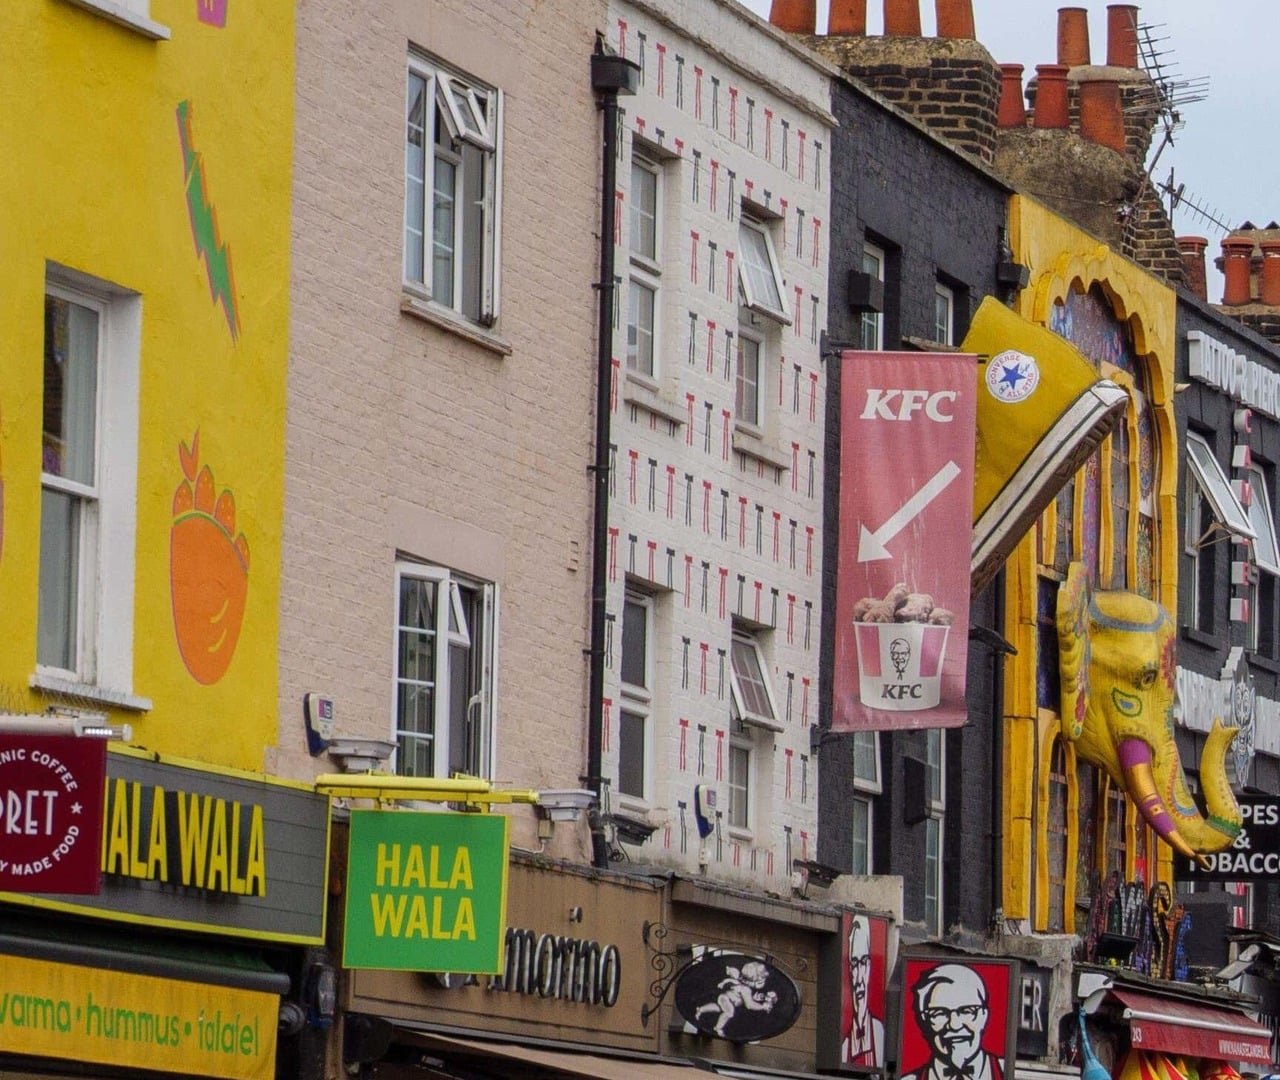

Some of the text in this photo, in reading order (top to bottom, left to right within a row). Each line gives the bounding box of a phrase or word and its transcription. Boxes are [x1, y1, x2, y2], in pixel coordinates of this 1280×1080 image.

[991, 354, 1020, 385] CONVERSE
[1188, 331, 1236, 395] TATTOO
[860, 389, 956, 423] KFC
[881, 683, 923, 700] KFC
[31, 750, 78, 792] COFFEE
[0, 789, 58, 836] RET
[12, 856, 52, 876] MADE
[52, 825, 80, 862] FOOD
[177, 789, 266, 898] WALA
[376, 843, 474, 891] HALA
[370, 893, 477, 942] WALA
[488, 906, 621, 1008] morino
[86, 992, 180, 1047] hummus
[198, 1008, 259, 1057] falafel
